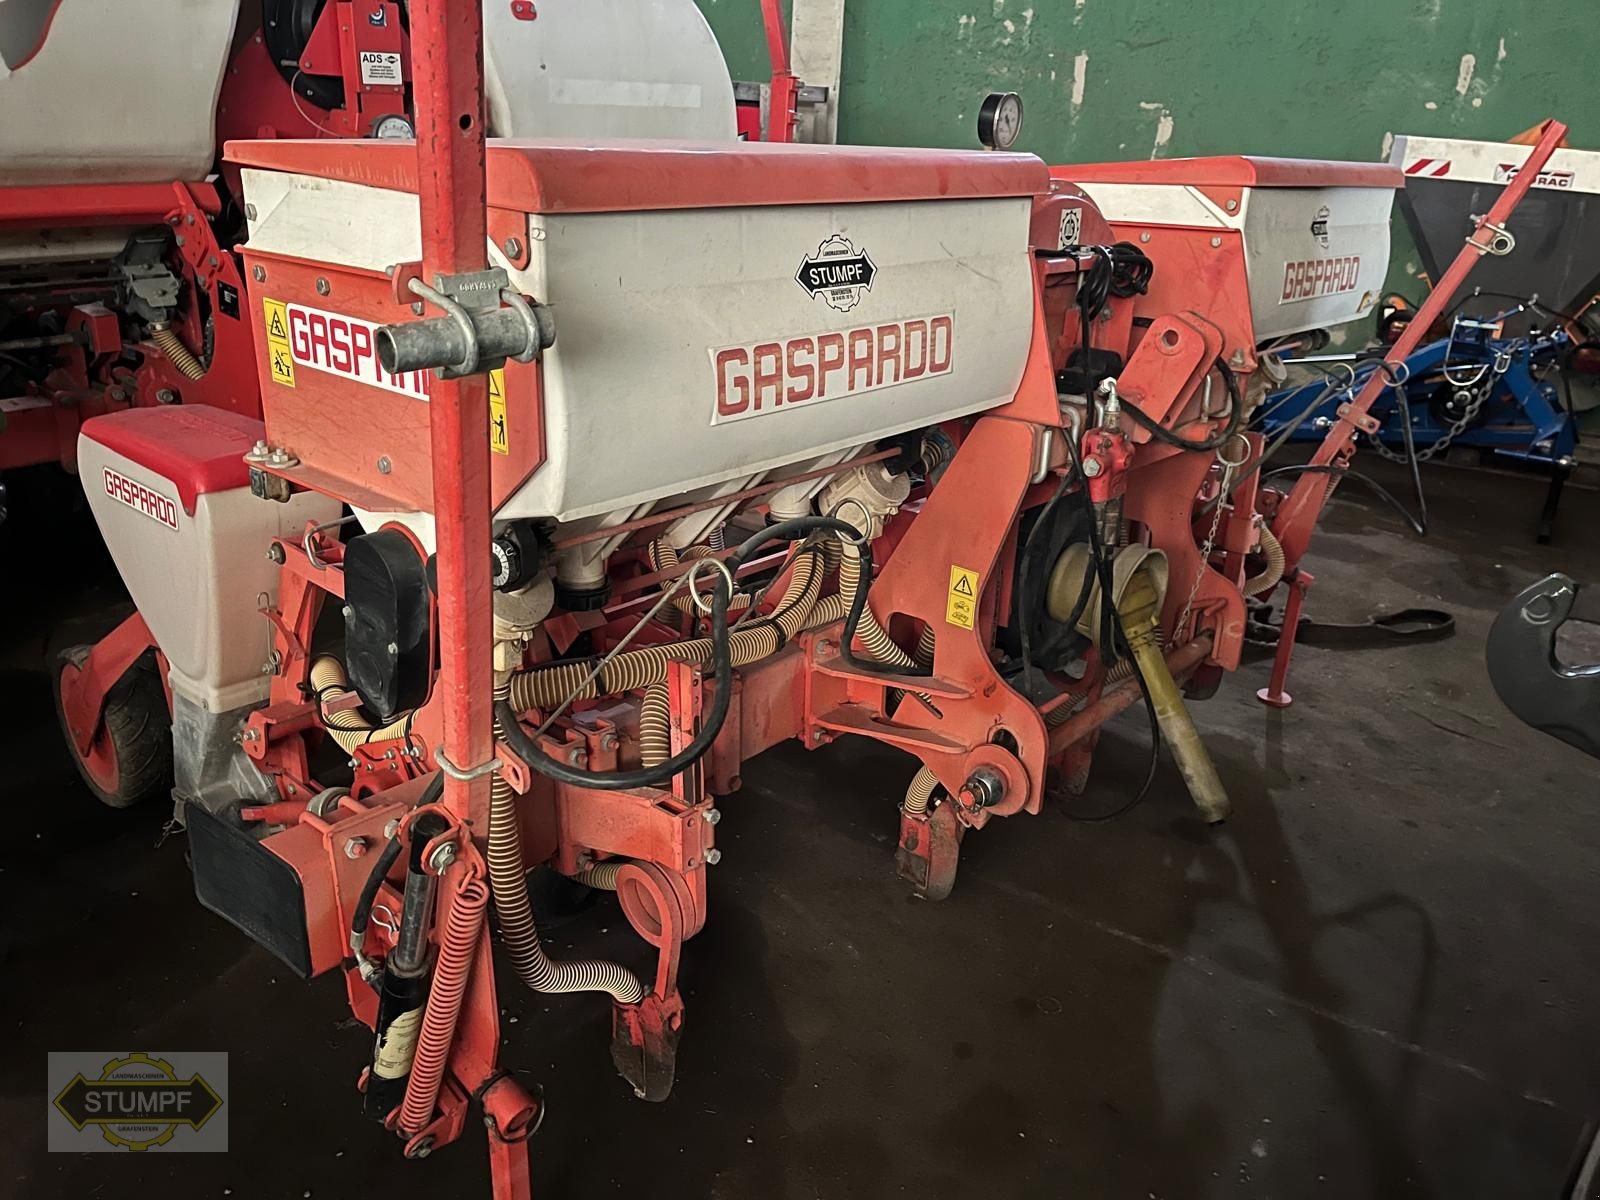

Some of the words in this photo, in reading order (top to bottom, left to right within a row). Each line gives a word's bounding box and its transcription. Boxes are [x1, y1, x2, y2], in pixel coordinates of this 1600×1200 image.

[362, 53, 383, 64] ADS
[809, 263, 863, 285] STUMPF
[1282, 256, 1360, 300] GASPARDO
[716, 315, 952, 417] GASPARDO
[104, 470, 177, 529] GASPARDO
